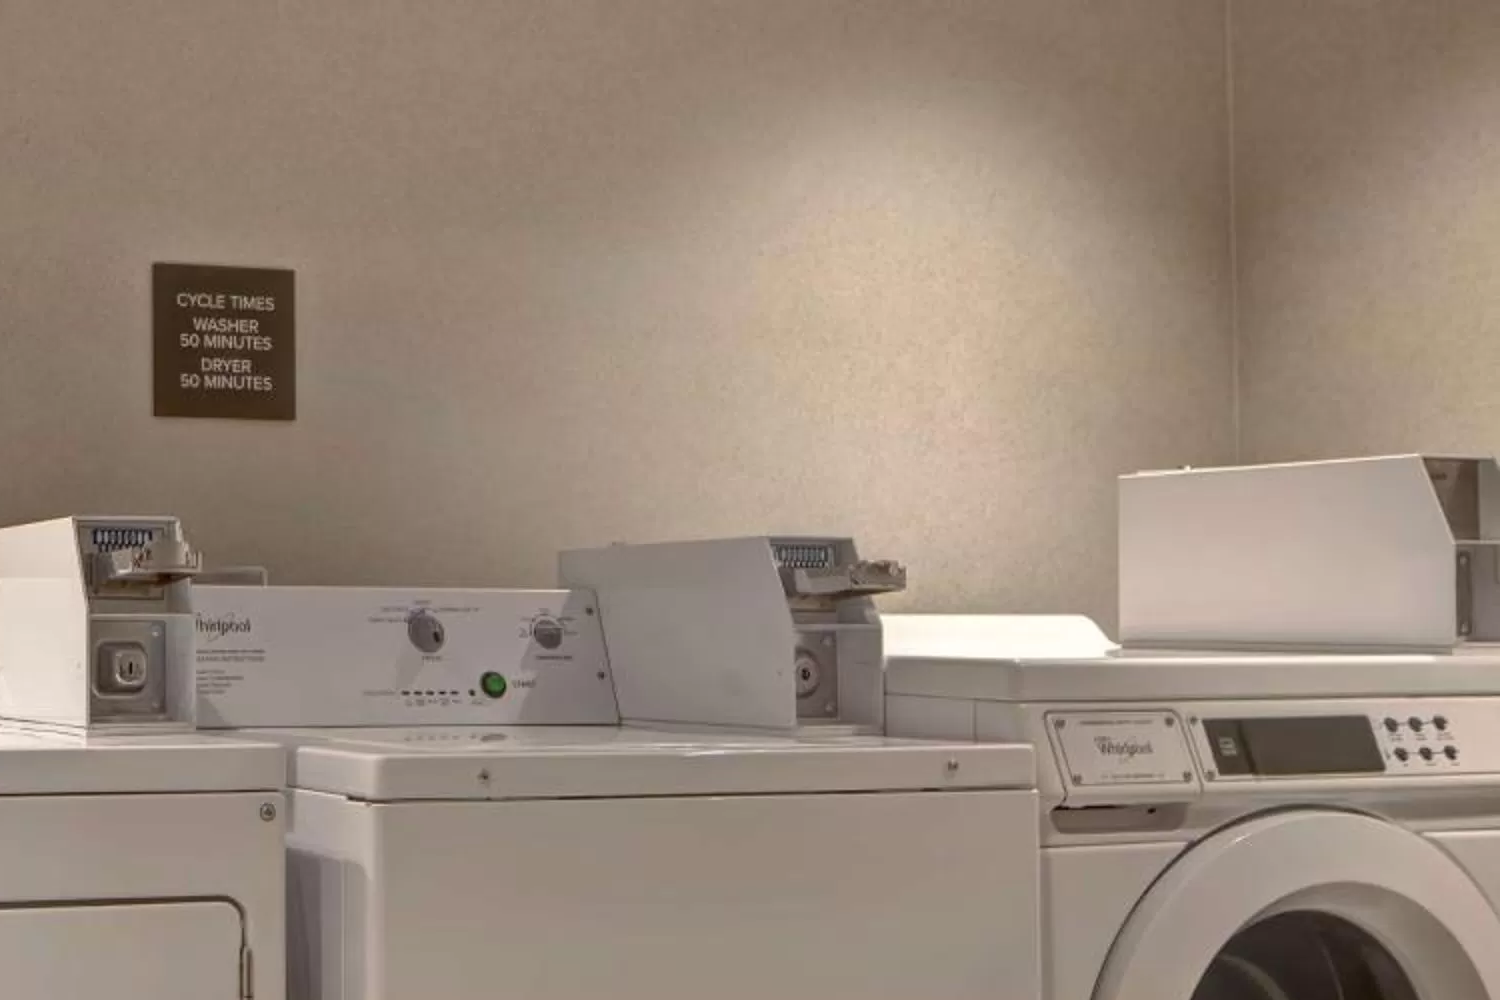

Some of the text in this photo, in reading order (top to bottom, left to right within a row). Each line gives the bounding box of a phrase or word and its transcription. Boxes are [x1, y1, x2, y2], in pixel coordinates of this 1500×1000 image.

[176, 293, 276, 312] CYCLE TIMES
[192, 317, 259, 334] WASHER
[179, 333, 273, 351] 50 MINUTES
[200, 357, 252, 373] DRYER
[180, 374, 273, 391] 50 MINUTES
